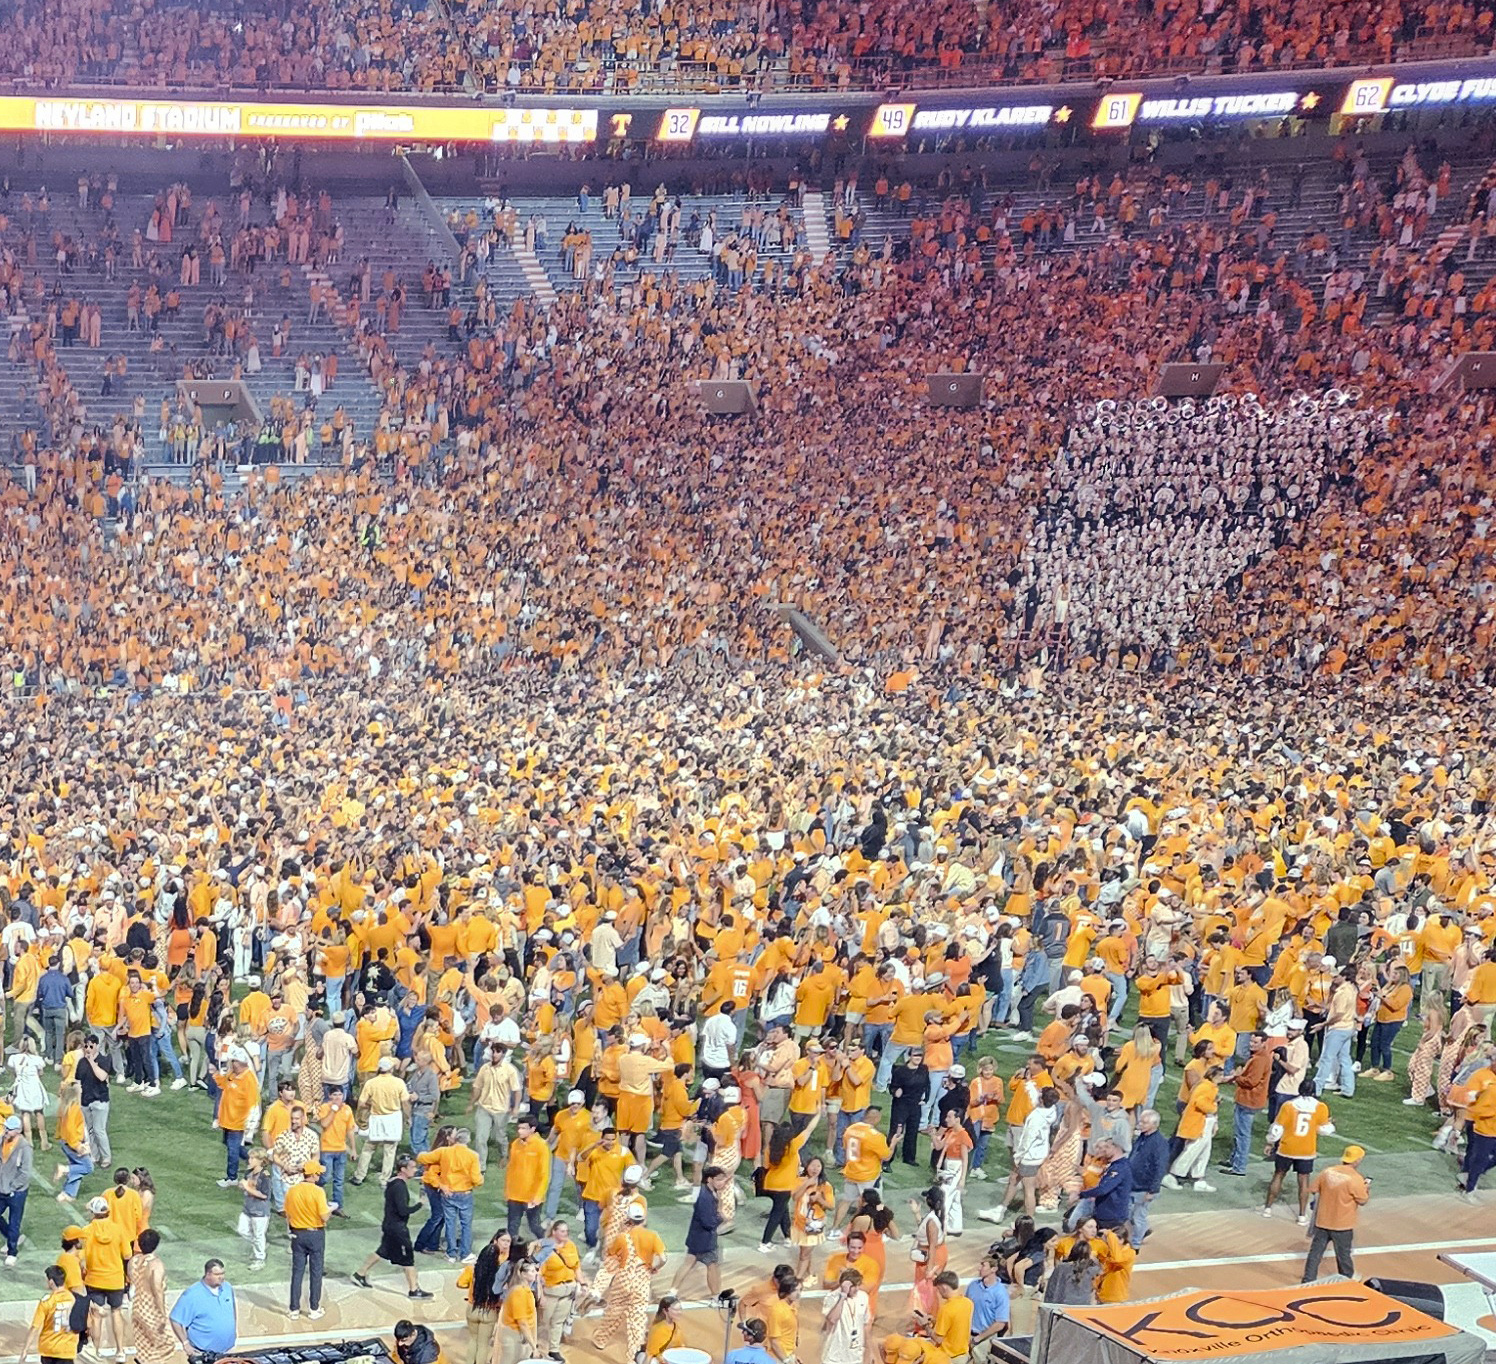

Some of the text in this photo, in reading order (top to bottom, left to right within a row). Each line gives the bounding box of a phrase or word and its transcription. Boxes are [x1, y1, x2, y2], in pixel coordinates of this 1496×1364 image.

[1355, 86, 1380, 106] 62
[1390, 78, 1496, 103] CLYDE FUS
[1108, 99, 1128, 121] 61
[1141, 91, 1298, 118] WILLIS TUCKER
[34, 101, 242, 132] NEYLAND STADIUM
[610, 114, 632, 136] T
[668, 110, 691, 134] 32
[881, 109, 903, 130] 49
[914, 111, 970, 129] RUDY
[1296, 1114, 1312, 1136] 6
